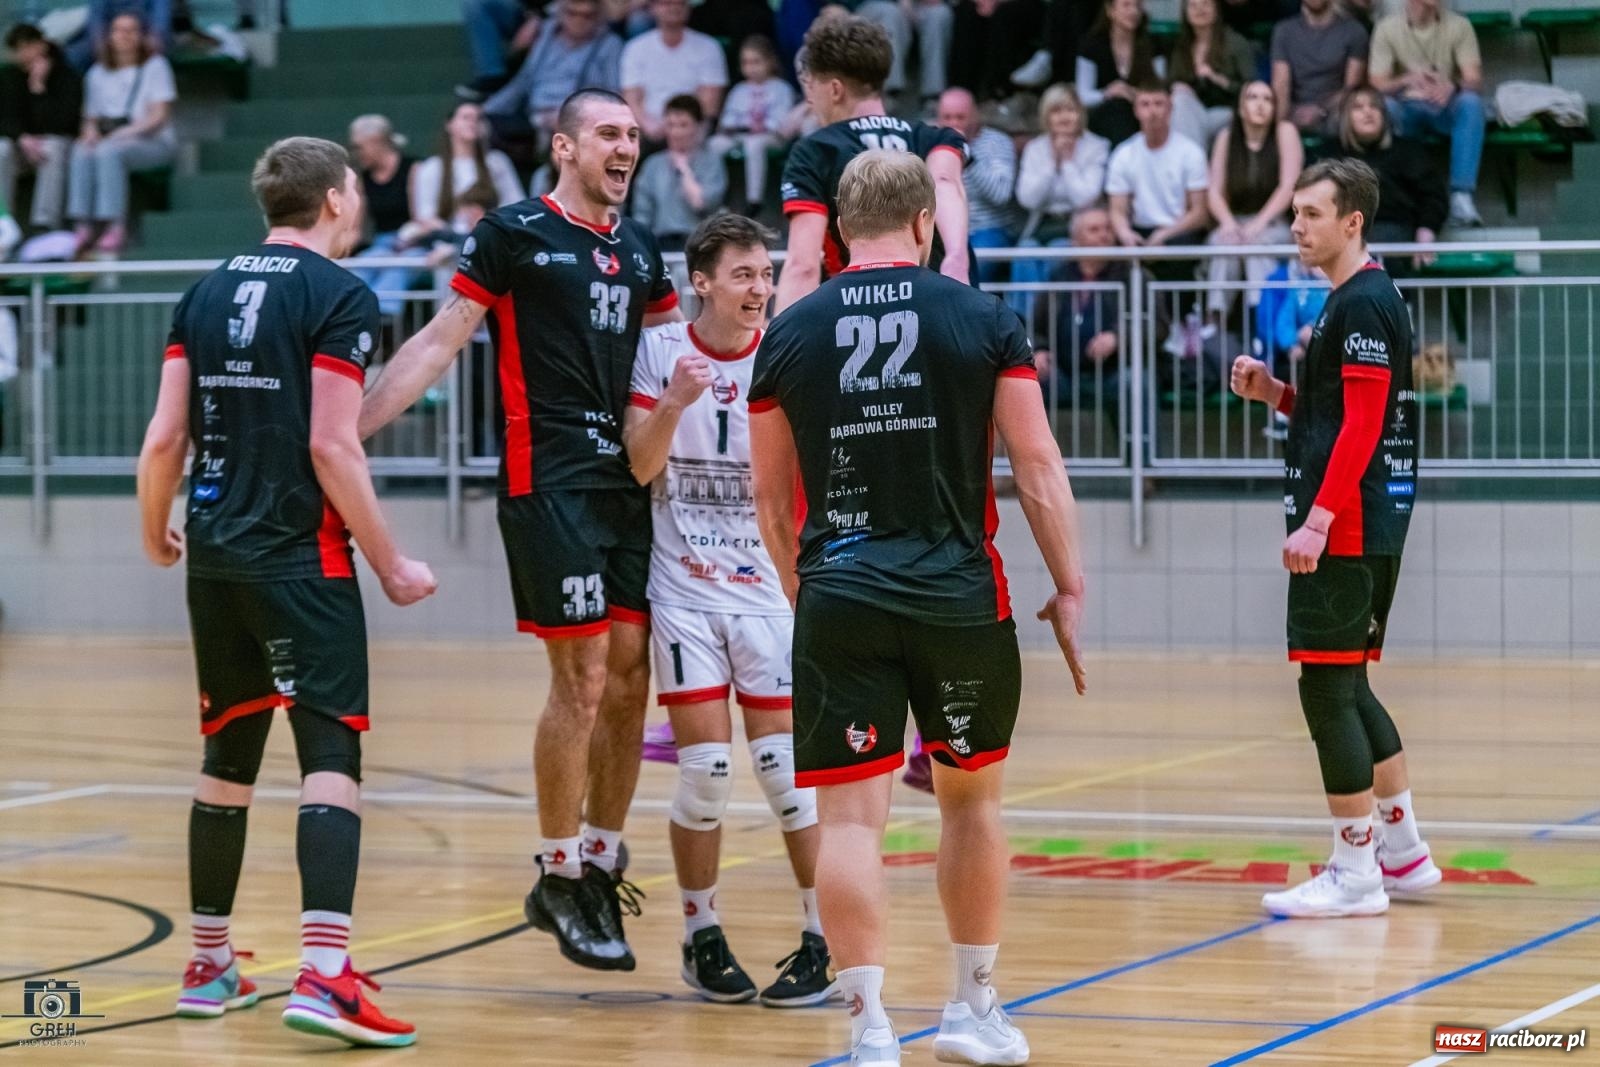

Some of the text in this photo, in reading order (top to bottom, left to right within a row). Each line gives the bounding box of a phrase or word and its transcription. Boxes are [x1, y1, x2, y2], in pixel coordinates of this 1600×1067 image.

[227, 255, 300, 273] DEMCIO
[228, 280, 268, 349] 3
[589, 281, 631, 334] 33
[841, 281, 913, 306] WIKŁO
[835, 310, 921, 394] 22
[830, 416, 937, 439] DĄBROWA GÓRNICZA
[862, 402, 903, 418] VOLLEY
[715, 410, 729, 455] 1
[836, 511, 869, 529] PHU AIP
[562, 574, 604, 620] 33
[670, 642, 684, 686] 1
